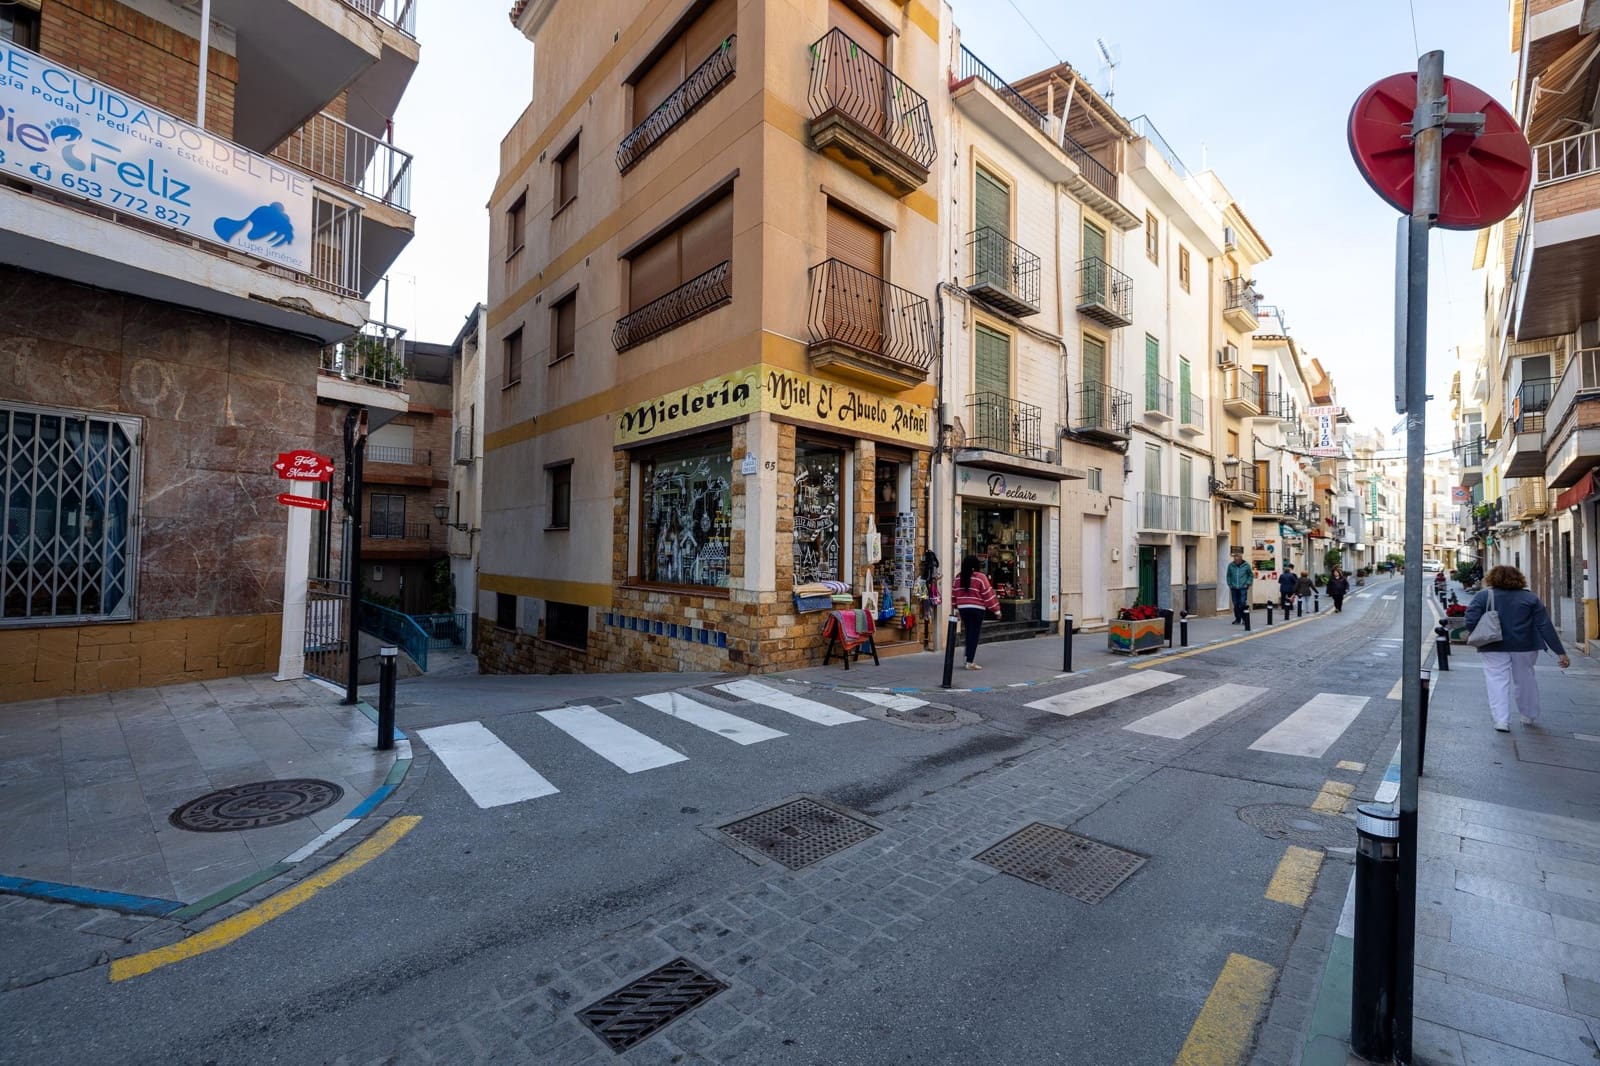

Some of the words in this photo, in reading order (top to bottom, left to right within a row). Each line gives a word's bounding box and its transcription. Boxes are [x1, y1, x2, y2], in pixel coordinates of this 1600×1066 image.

[0, 48, 29, 79] E
[42, 69, 203, 150] CUIDADO
[212, 142, 261, 178] DEL
[269, 166, 304, 197] PIE
[31, 86, 80, 113] Podal
[97, 113, 163, 148] Pedicura
[0, 104, 50, 152] ie
[90, 138, 191, 207] Feliz
[61, 173, 103, 198] 653
[110, 188, 149, 214] 772
[155, 204, 191, 227] 827
[620, 380, 750, 437] Mielería
[767, 370, 810, 410] Miel
[816, 384, 832, 418] El
[838, 391, 887, 424] Abuelo
[891, 404, 927, 434] Rafael
[286, 467, 323, 478] Navidad
